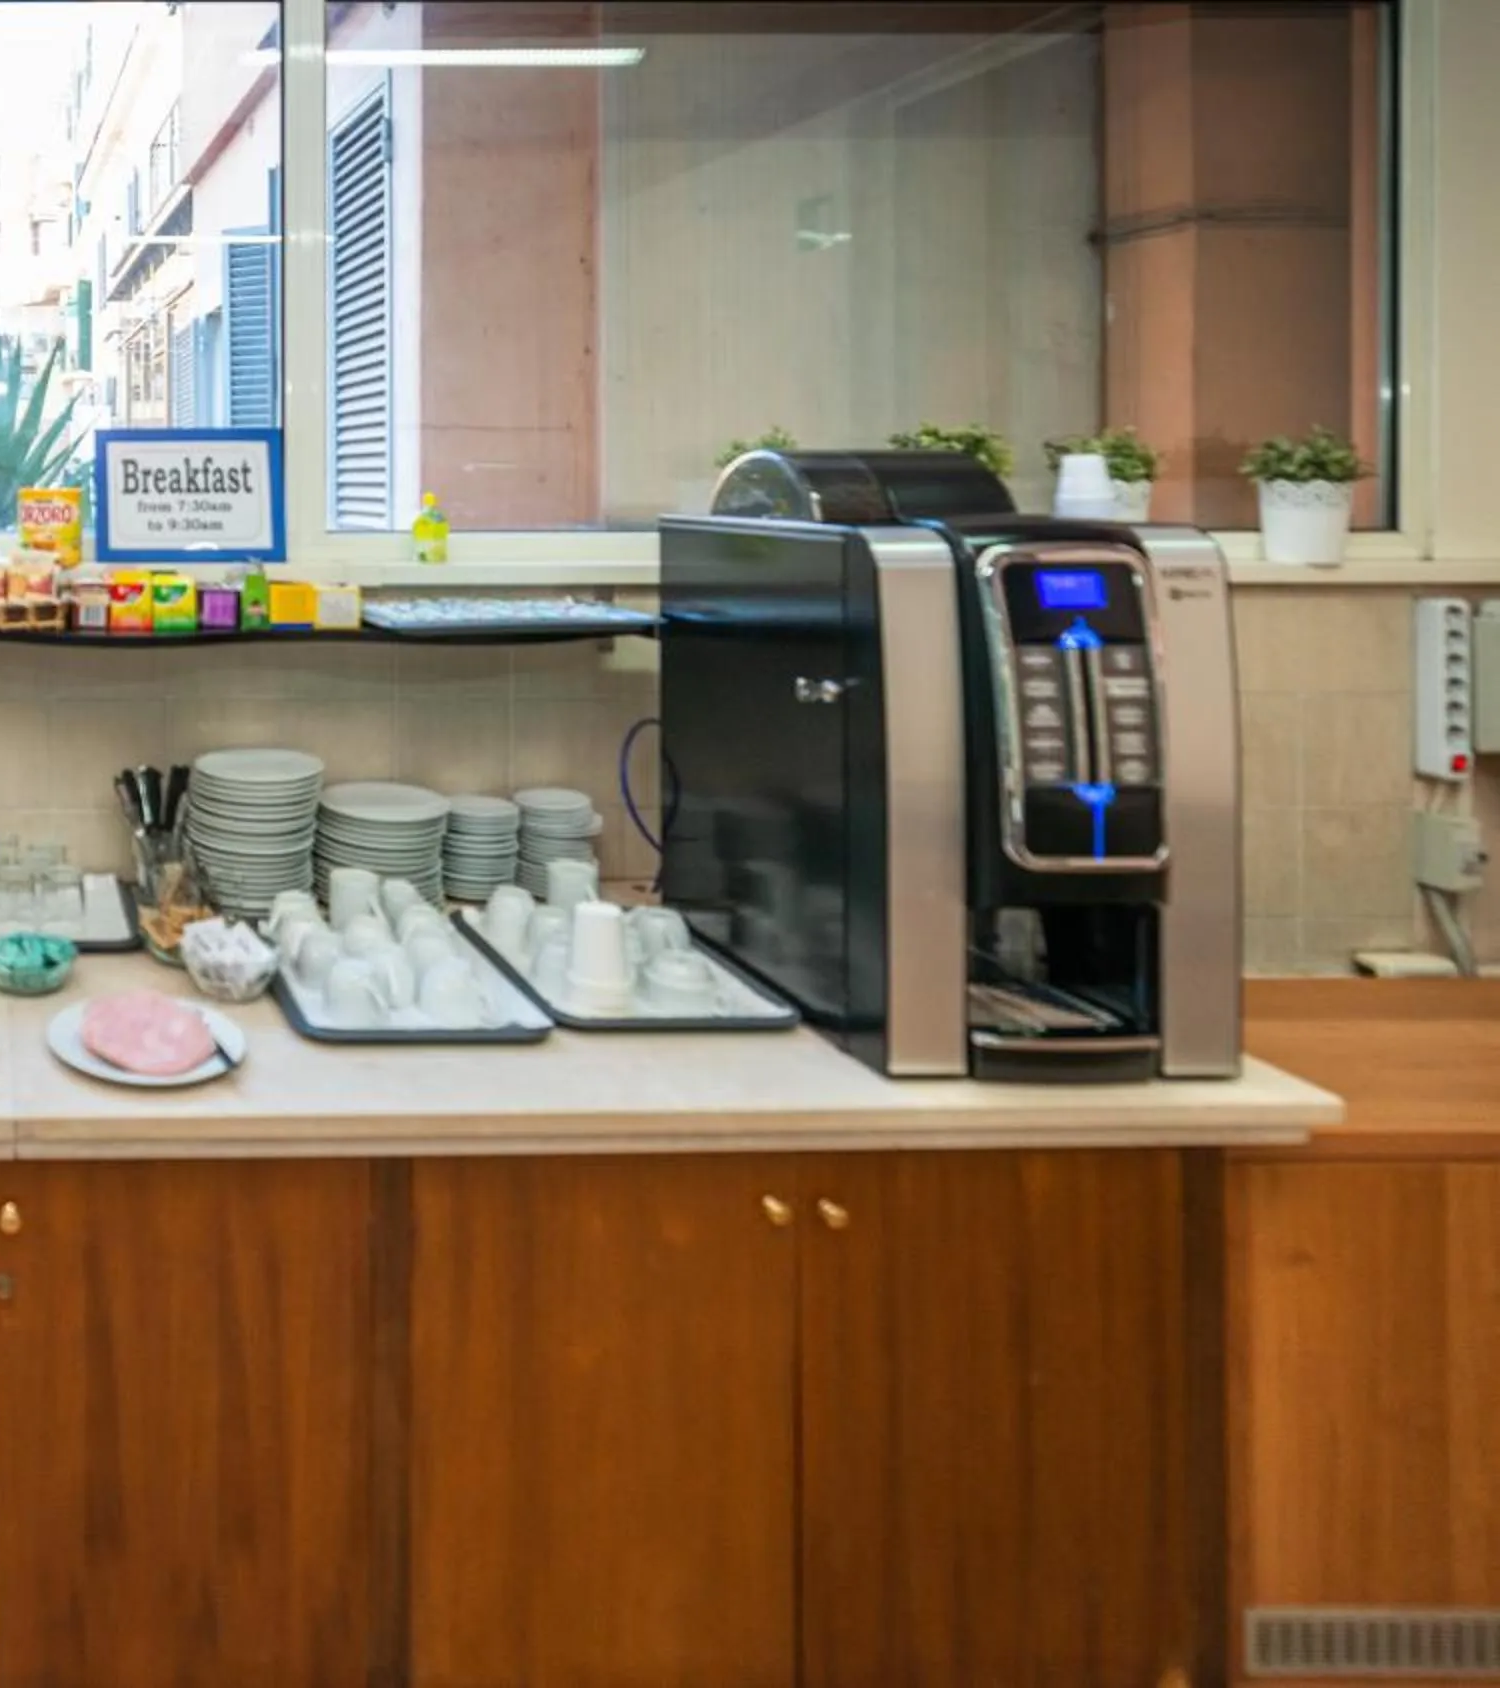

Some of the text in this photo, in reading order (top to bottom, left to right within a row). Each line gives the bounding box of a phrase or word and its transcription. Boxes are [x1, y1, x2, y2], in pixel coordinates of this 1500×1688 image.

[121, 457, 253, 495] Breakfast
[137, 500, 233, 513] from 7:30am
[148, 518, 223, 531] to 9:30am
